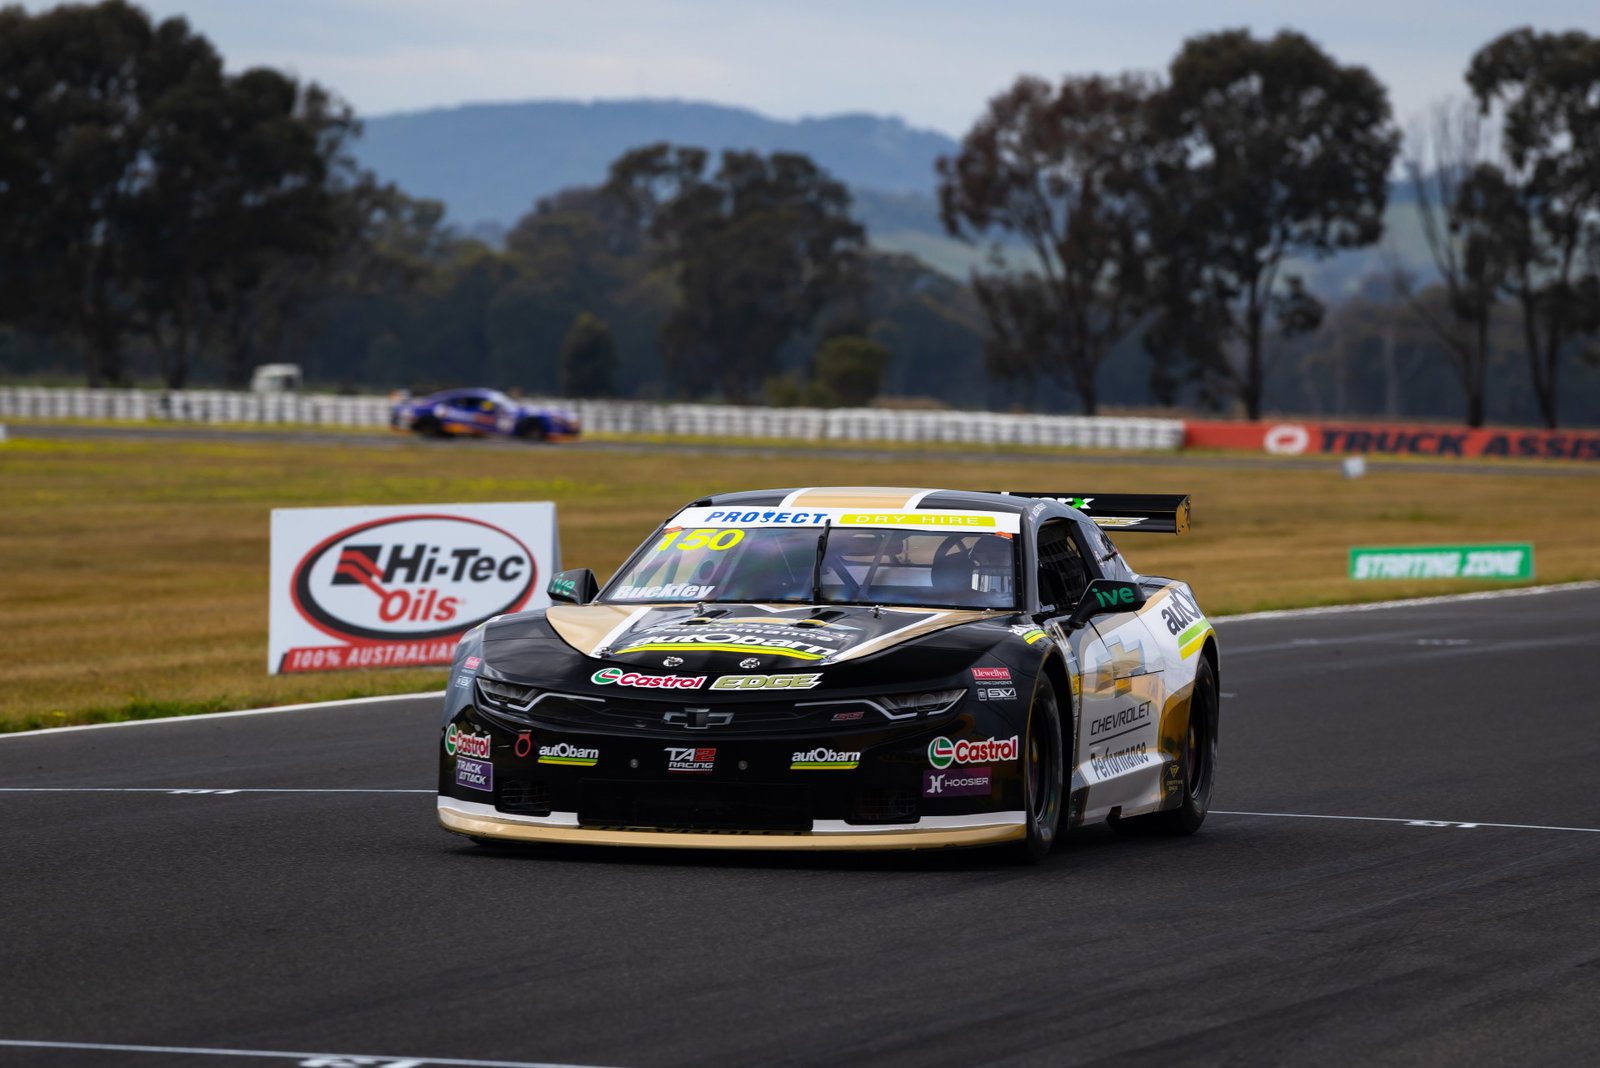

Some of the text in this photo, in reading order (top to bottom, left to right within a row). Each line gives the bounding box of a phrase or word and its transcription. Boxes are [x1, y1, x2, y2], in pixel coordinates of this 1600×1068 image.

[1321, 430, 1467, 457] TRUCK
[855, 515, 907, 524] DRY
[921, 516, 979, 525] HIRE
[656, 529, 745, 551] 150
[382, 544, 525, 583] Hi-Tec
[1354, 550, 1523, 579] STARTING ZONE
[611, 583, 716, 599] Buckley
[1092, 586, 1136, 608] ive
[378, 588, 458, 622] Oils
[292, 652, 342, 668] 100%
[345, 643, 457, 665] AUSTRALIA
[620, 674, 819, 688] Castrol EDGE
[973, 669, 1009, 679] Llewellyn
[1091, 700, 1152, 736] CHEVROLET
[456, 730, 491, 758] Castrol
[664, 747, 717, 761] TA2
[954, 736, 1018, 763] Castrol
[456, 759, 482, 774] TRACK
[668, 761, 714, 769] RACING
[1090, 741, 1150, 780] Performance
[459, 773, 486, 785] ATTACK
[945, 777, 989, 787] HOOSIER
